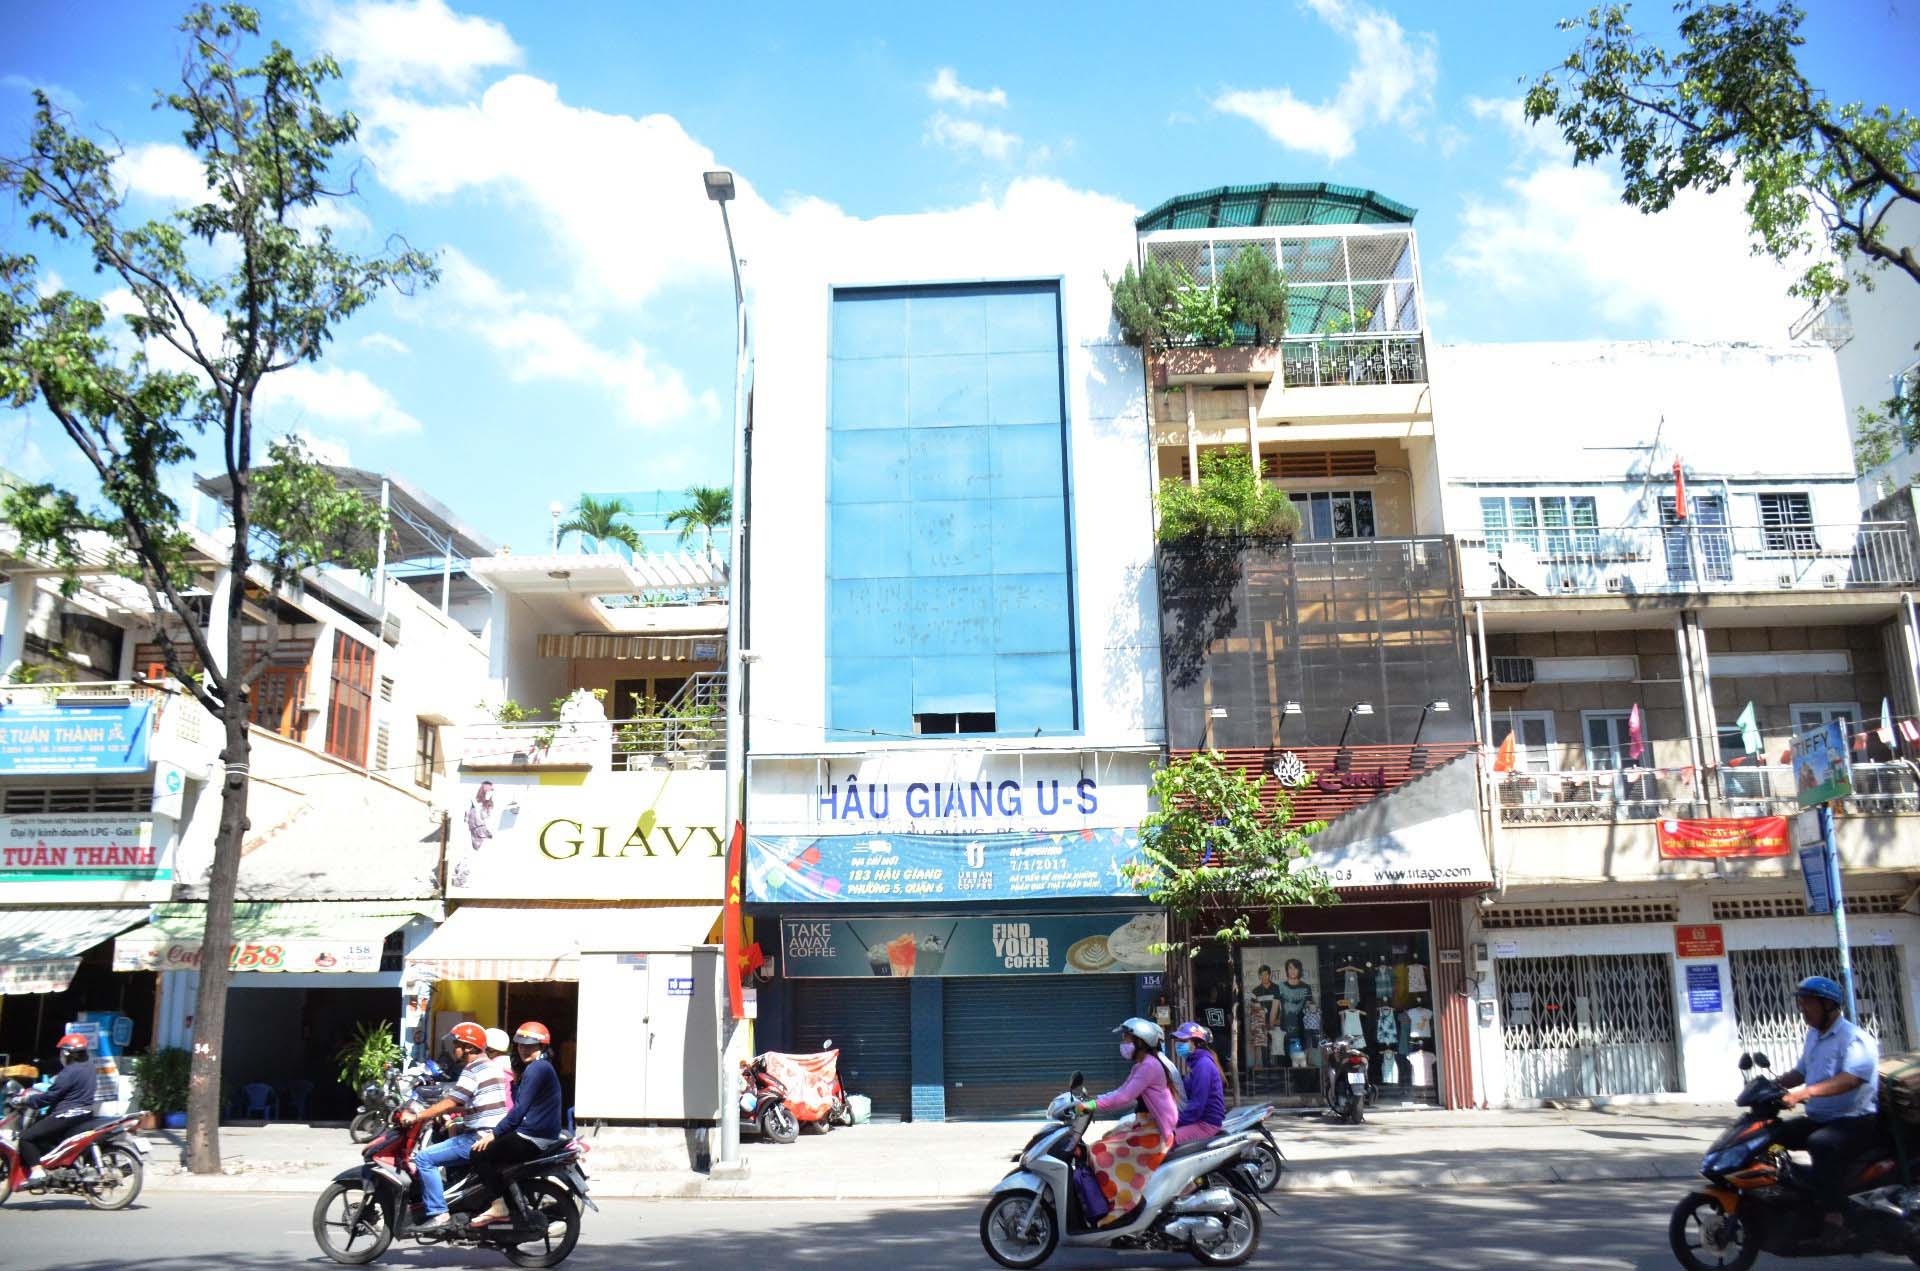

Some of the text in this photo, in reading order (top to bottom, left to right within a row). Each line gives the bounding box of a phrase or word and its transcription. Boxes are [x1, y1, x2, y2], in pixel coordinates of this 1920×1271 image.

[906, 780, 1024, 818] GIANG
[1037, 778, 1098, 816] U-S
[91, 827, 108, 837] LPG
[116, 827, 133, 837] Gas
[540, 818, 726, 860] GIAVY
[74, 842, 156, 866] THÀNH
[1010, 858, 1067, 871] 7/1/2017
[1374, 866, 1472, 881] www.titago.com
[789, 924, 831, 936] TAKE
[992, 923, 1031, 938] FIND
[789, 936, 831, 948] AWAY
[992, 937, 1049, 957] YOUR
[348, 946, 370, 954] 158
[789, 947, 836, 958] COFFEE
[227, 945, 285, 969] 158
[1004, 956, 1050, 969] COFFEE
[1144, 976, 1160, 985] 154
